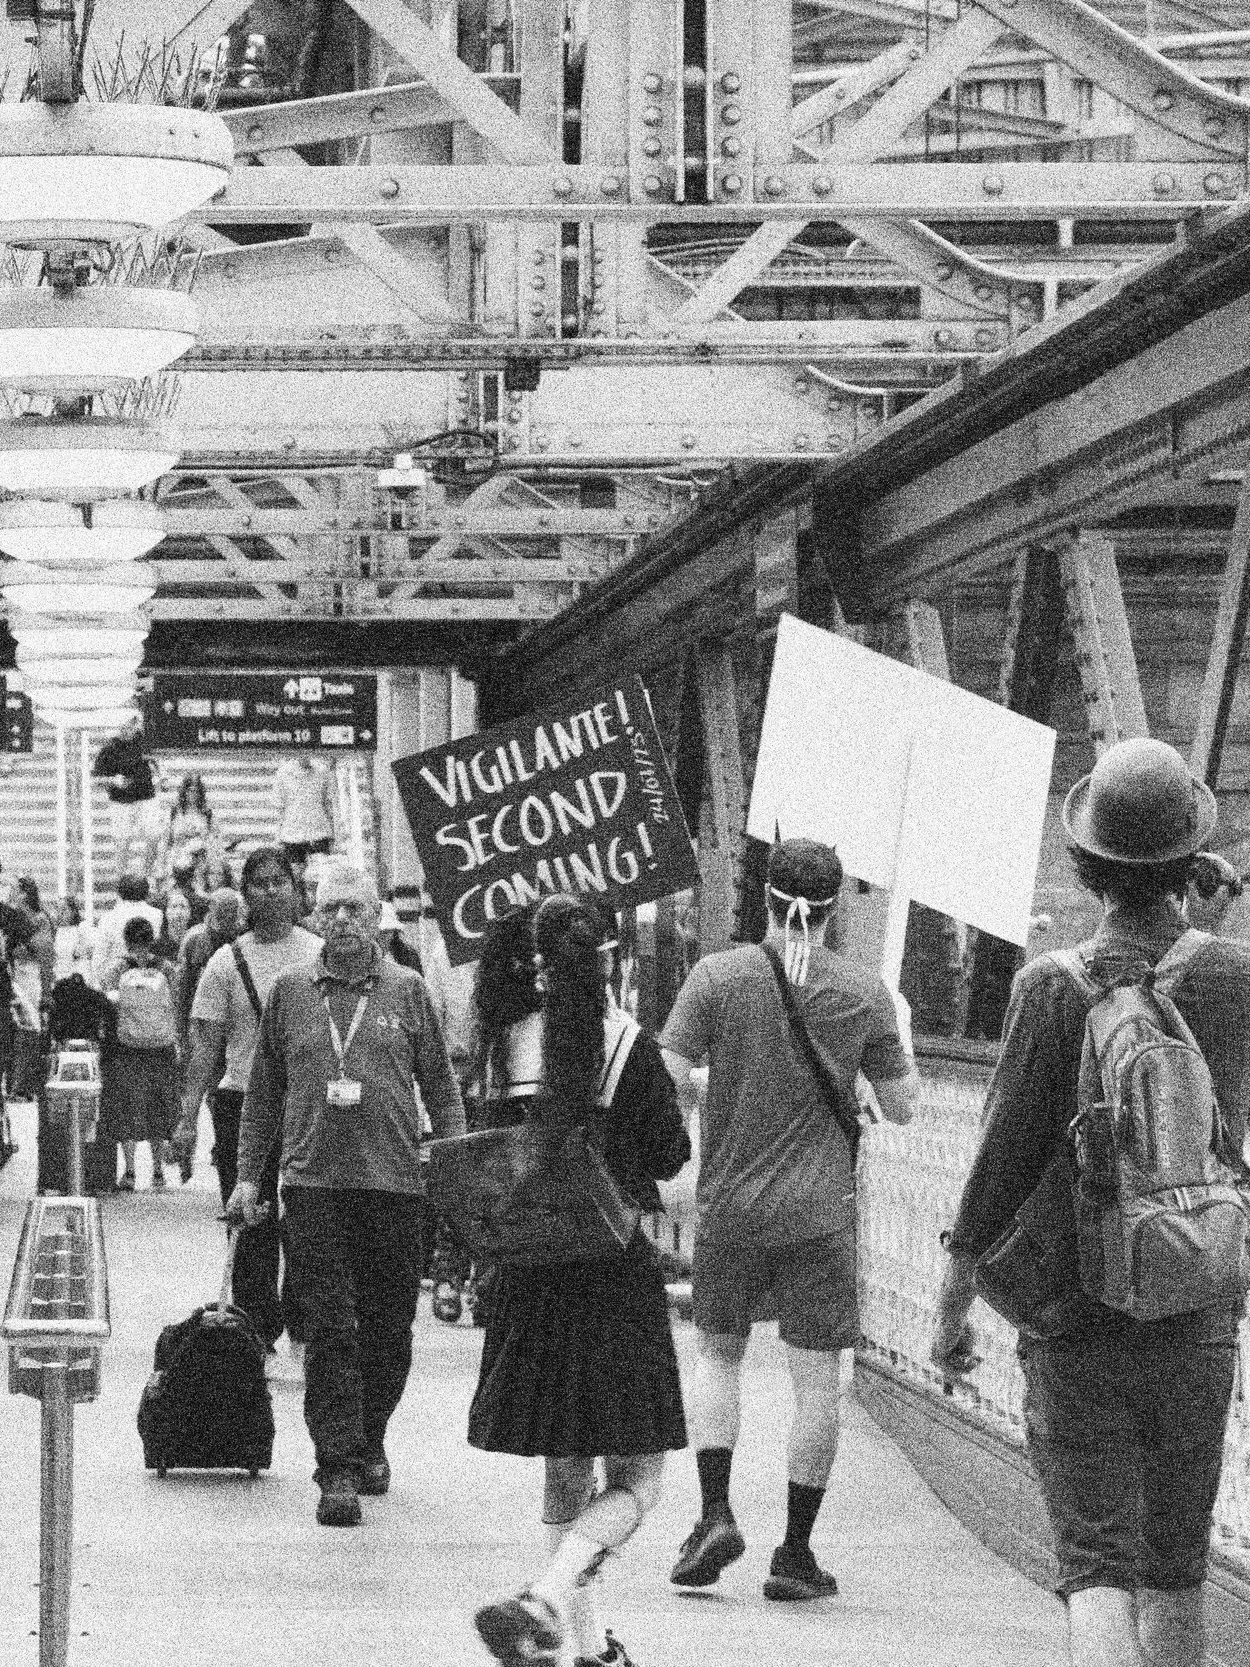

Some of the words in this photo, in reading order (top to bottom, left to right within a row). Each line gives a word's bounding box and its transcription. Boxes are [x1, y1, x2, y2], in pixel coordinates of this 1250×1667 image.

[255, 703, 281, 718] Way
[323, 682, 354, 695] Taxis
[200, 729, 220, 743] Lift
[222, 731, 236, 743] to
[238, 729, 292, 744] platform
[294, 729, 311, 743] 10
[419, 690, 634, 808] VIGILANTE!
[435, 771, 627, 871] SECOND
[453, 822, 657, 939] COMING!
